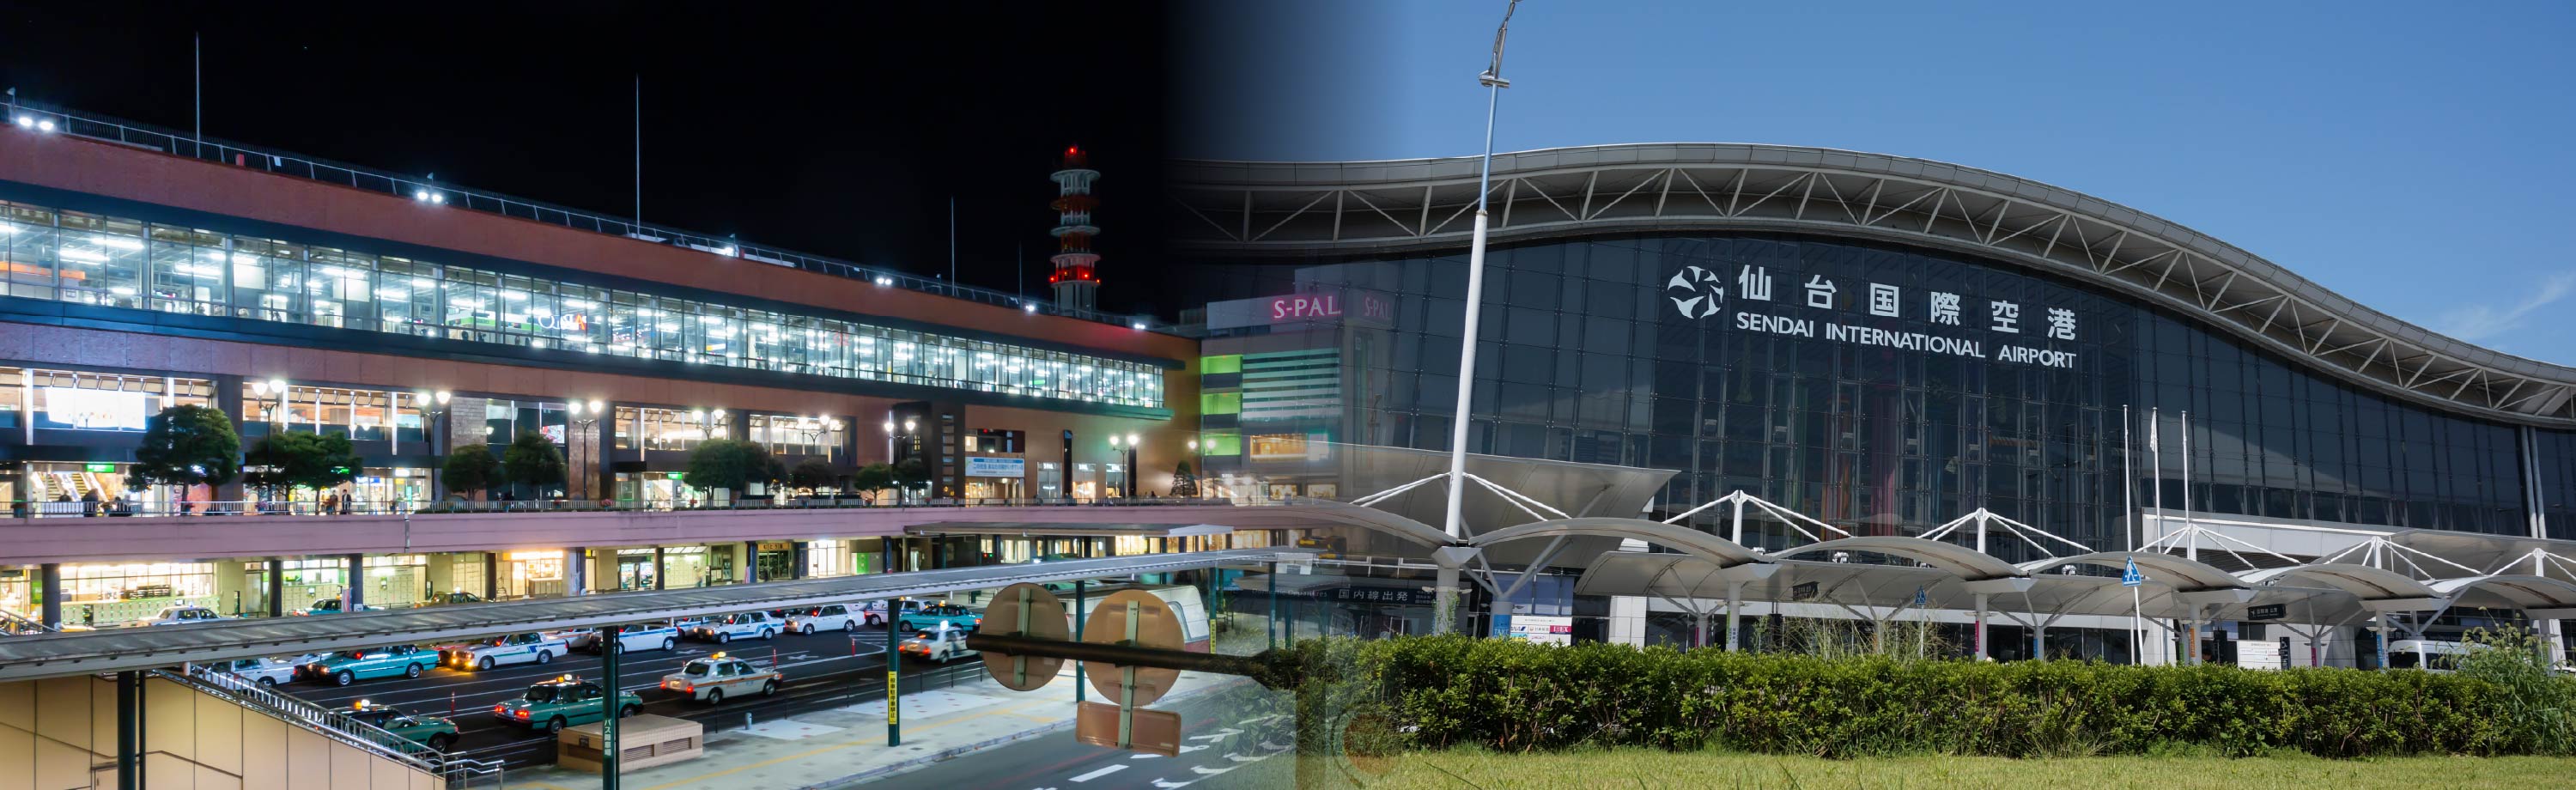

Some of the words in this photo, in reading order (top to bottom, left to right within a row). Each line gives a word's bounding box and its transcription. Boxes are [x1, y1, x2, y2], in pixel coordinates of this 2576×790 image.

[1273, 295, 1341, 319] S-PAL
[1737, 264, 2077, 341] 仙台国際空港
[1736, 312, 1814, 338] SENDAI
[1826, 322, 1986, 358] INTERNATIONAL
[1998, 344, 2077, 368] AIRPORT
[1338, 589, 1409, 601] 国内線出発
